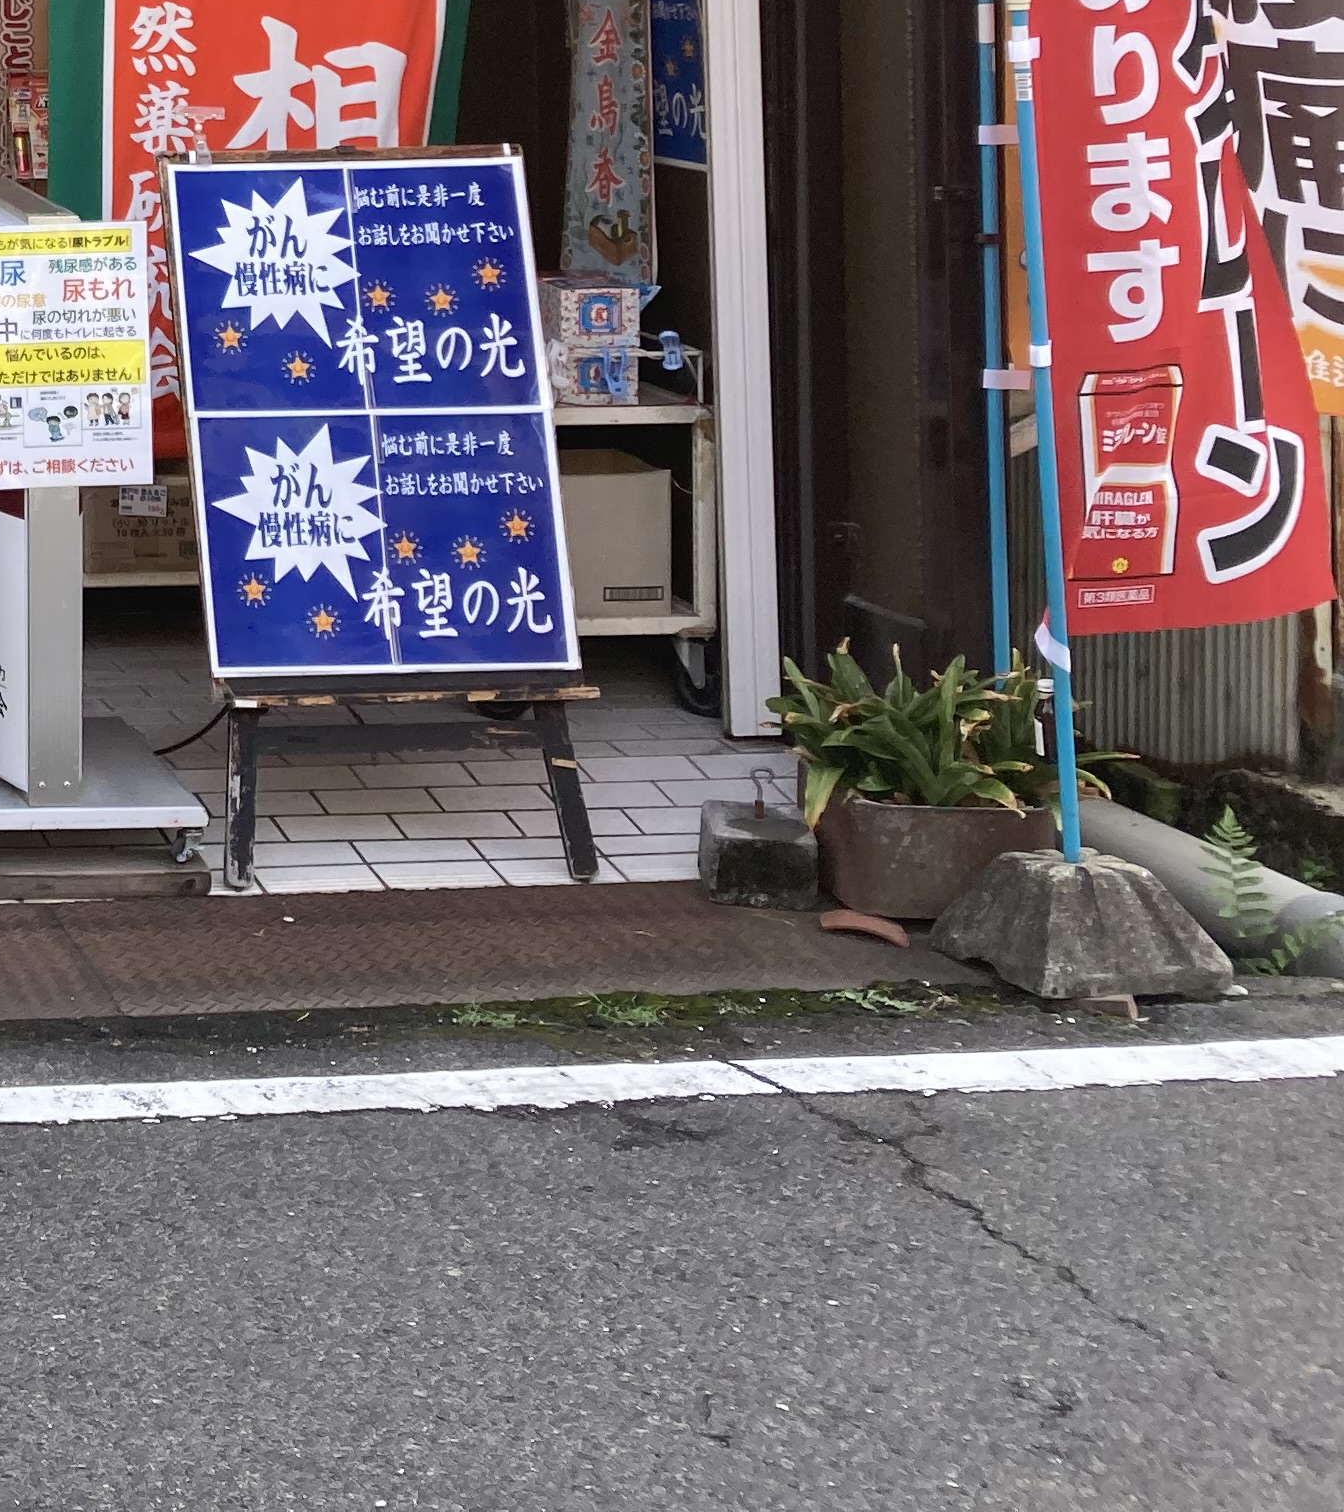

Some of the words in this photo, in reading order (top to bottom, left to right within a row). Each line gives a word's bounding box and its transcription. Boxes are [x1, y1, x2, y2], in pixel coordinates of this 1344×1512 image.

[353, 182, 485, 210] 悩む前に是非一度
[248, 214, 308, 257] がん
[358, 220, 515, 247] お話しをお聞かせ下さい
[48, 257, 137, 274] 残尿感がある
[234, 259, 331, 297] 慢性病に
[62, 278, 136, 303] 尿もれ
[32, 308, 136, 326] 尿の切れが悪い
[335, 311, 527, 385] 希望の光
[381, 431, 515, 458] 悩む前に是非一度
[270, 461, 332, 509] がん
[385, 471, 544, 497] お話しをお聞かせ下さい
[258, 510, 355, 548] 慢性病に
[362, 565, 555, 640] 希望の光
